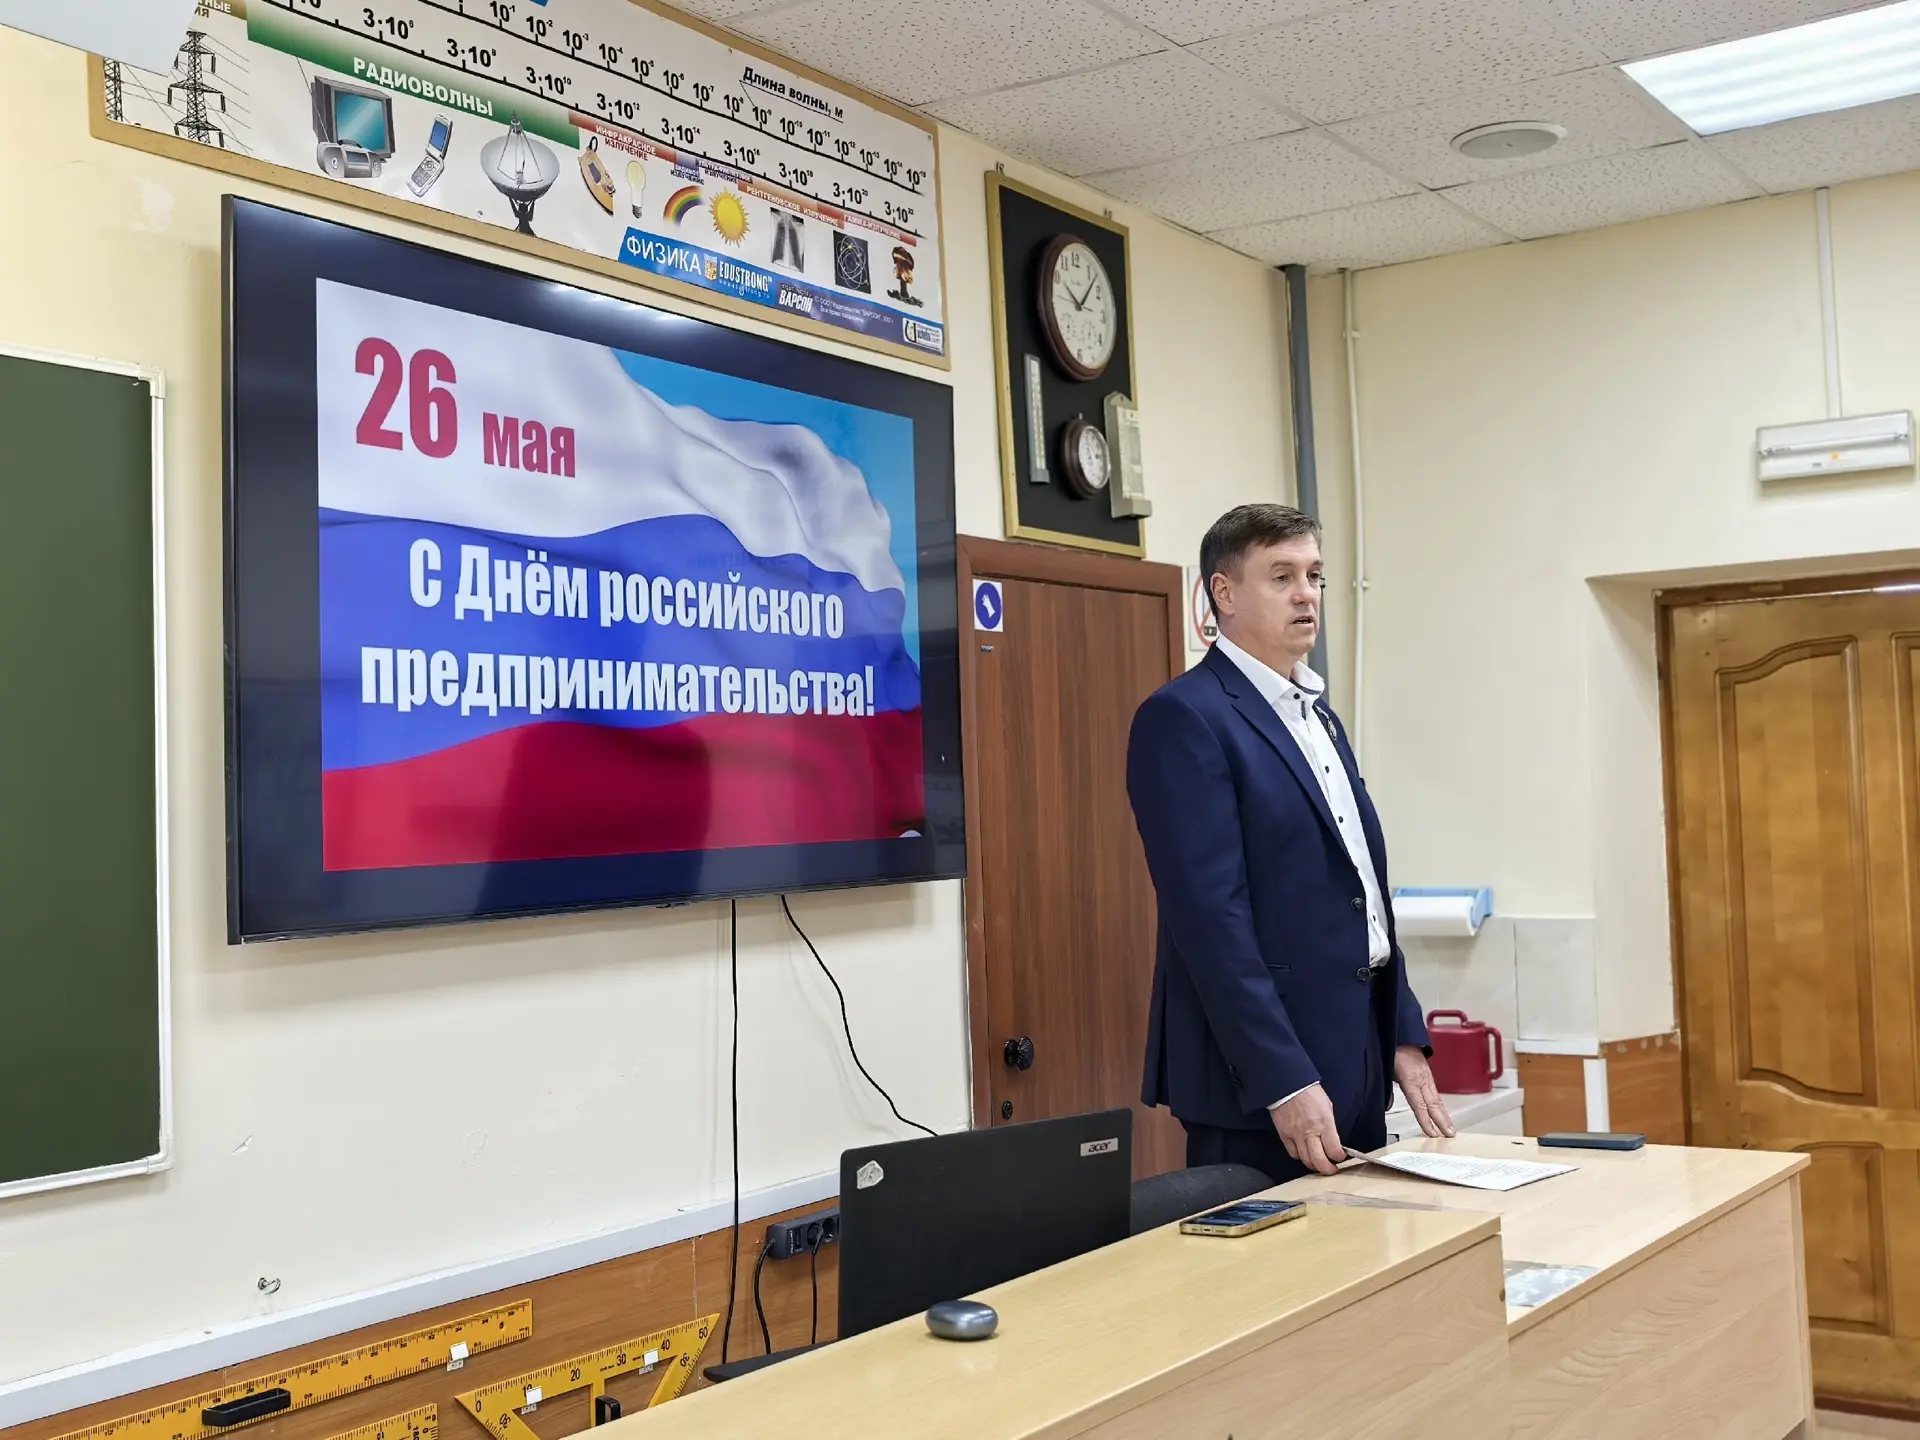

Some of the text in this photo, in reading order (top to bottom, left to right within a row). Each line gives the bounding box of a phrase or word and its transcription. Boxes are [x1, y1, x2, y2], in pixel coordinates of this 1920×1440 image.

[353, 57, 493, 116] РАДИОВОЛНЫ
[743, 67, 844, 119] Длина волны, м
[596, 125, 656, 155] ИНФРАКРАСНОЕ
[604, 138, 648, 161] ИЗЛУЧЕНИЕ
[746, 186, 839, 227] РЕНТГЕНОВСКОЕ ИЗЛУЧЕНИЕ
[626, 235, 702, 275] ФИЗИКА
[779, 290, 813, 313] ВАРСОН
[355, 337, 577, 479] 26 мая
[409, 538, 844, 639] С Днём российского
[360, 645, 875, 717] предпринимательства!
[1088, 1141, 1112, 1152] acer
[570, 1367, 581, 1381] 20
[616, 1353, 627, 1366] 30
[661, 1339, 670, 1351] 40
[698, 1326, 709, 1339] 50
